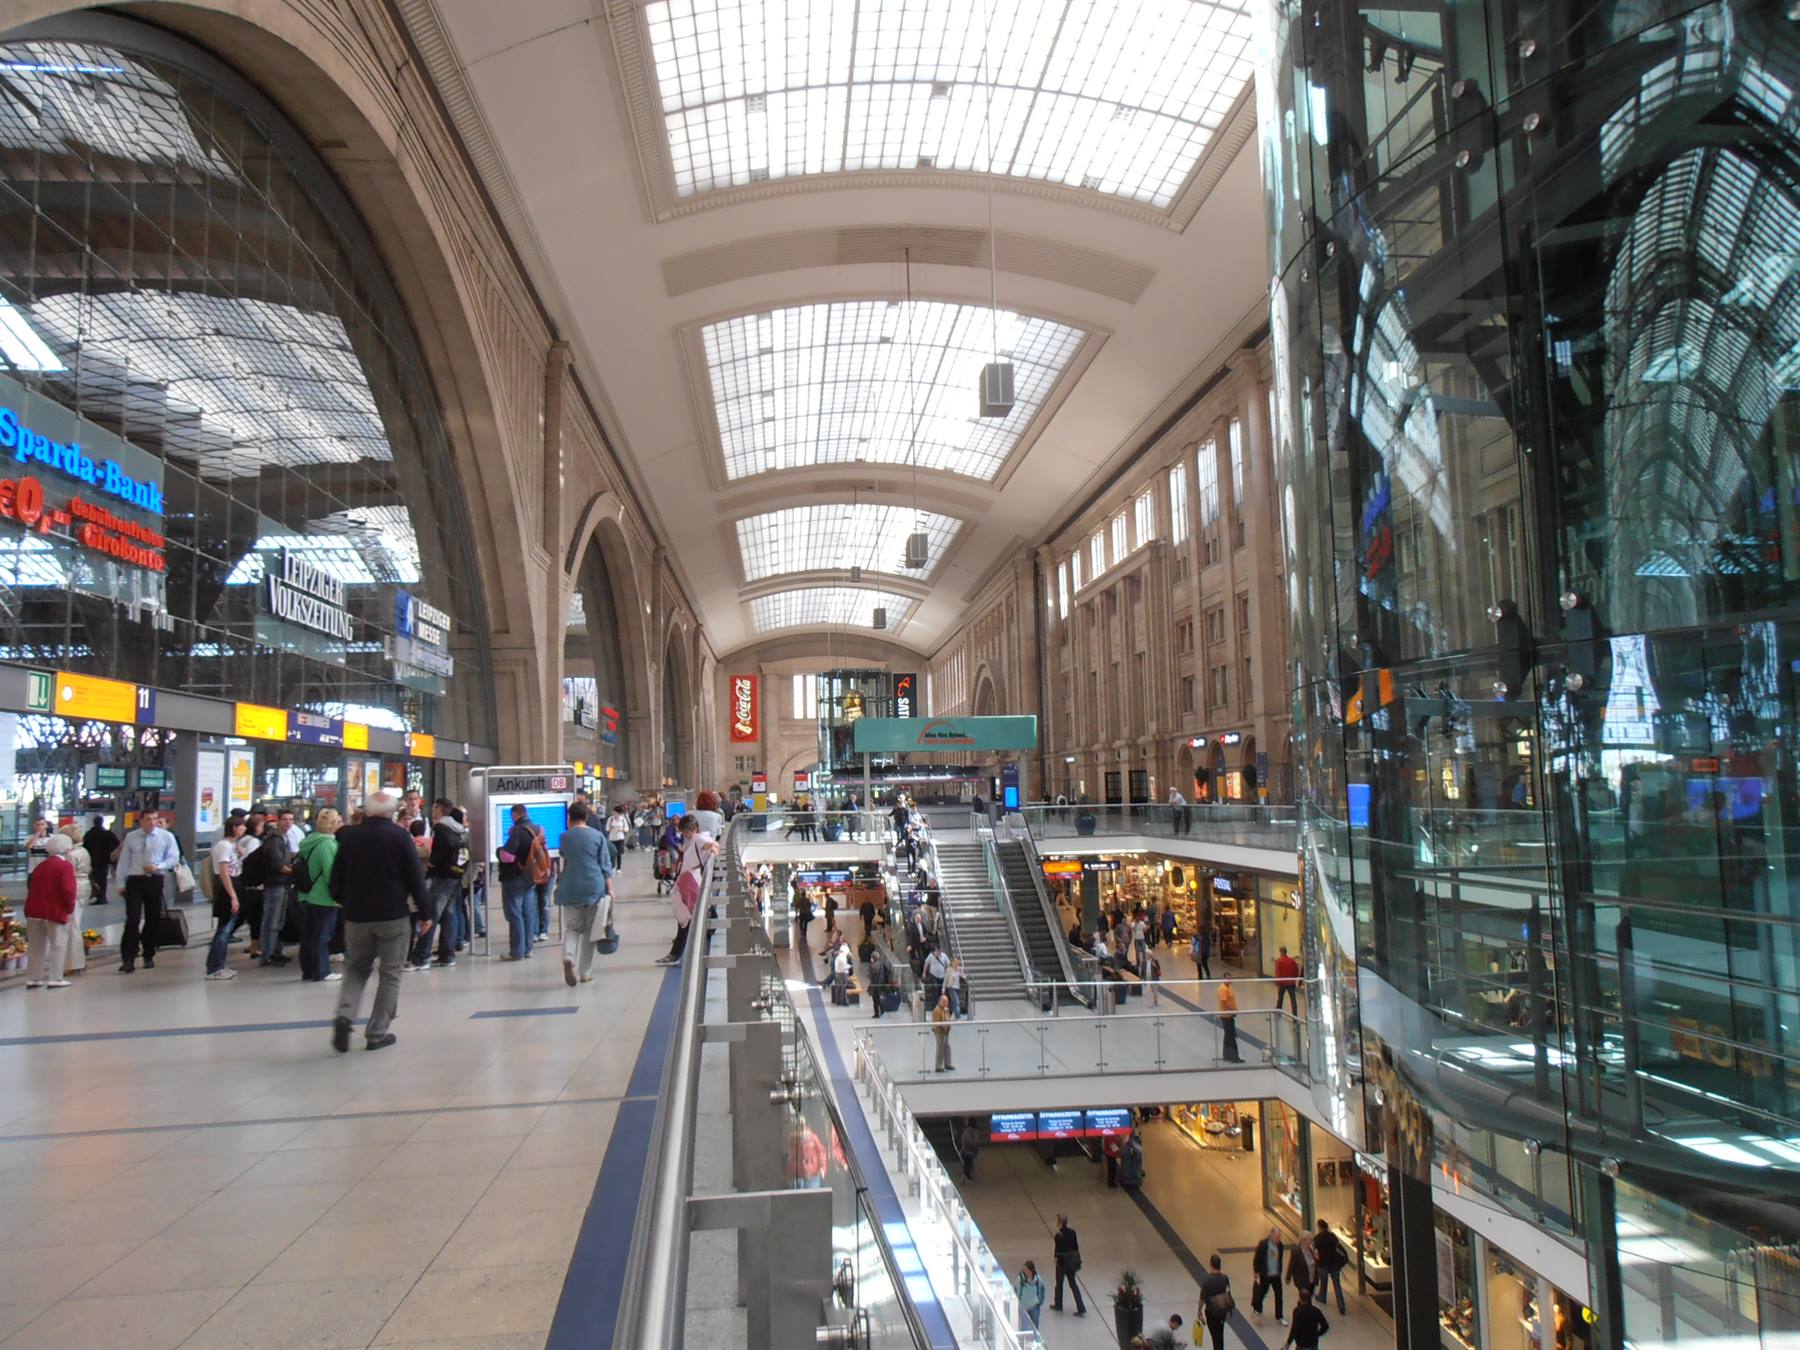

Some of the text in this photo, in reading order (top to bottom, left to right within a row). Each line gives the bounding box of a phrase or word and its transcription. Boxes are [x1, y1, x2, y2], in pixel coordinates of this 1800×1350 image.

[0, 406, 163, 514] Sparda-Bank
[83, 523, 165, 572] Girokonto
[283, 547, 343, 606] LEIPZIGER
[269, 574, 354, 641] VOLKSZEITUNG
[418, 621, 441, 645] MESSE
[138, 687, 150, 709] 11
[496, 776, 567, 792] Ankunft DB
